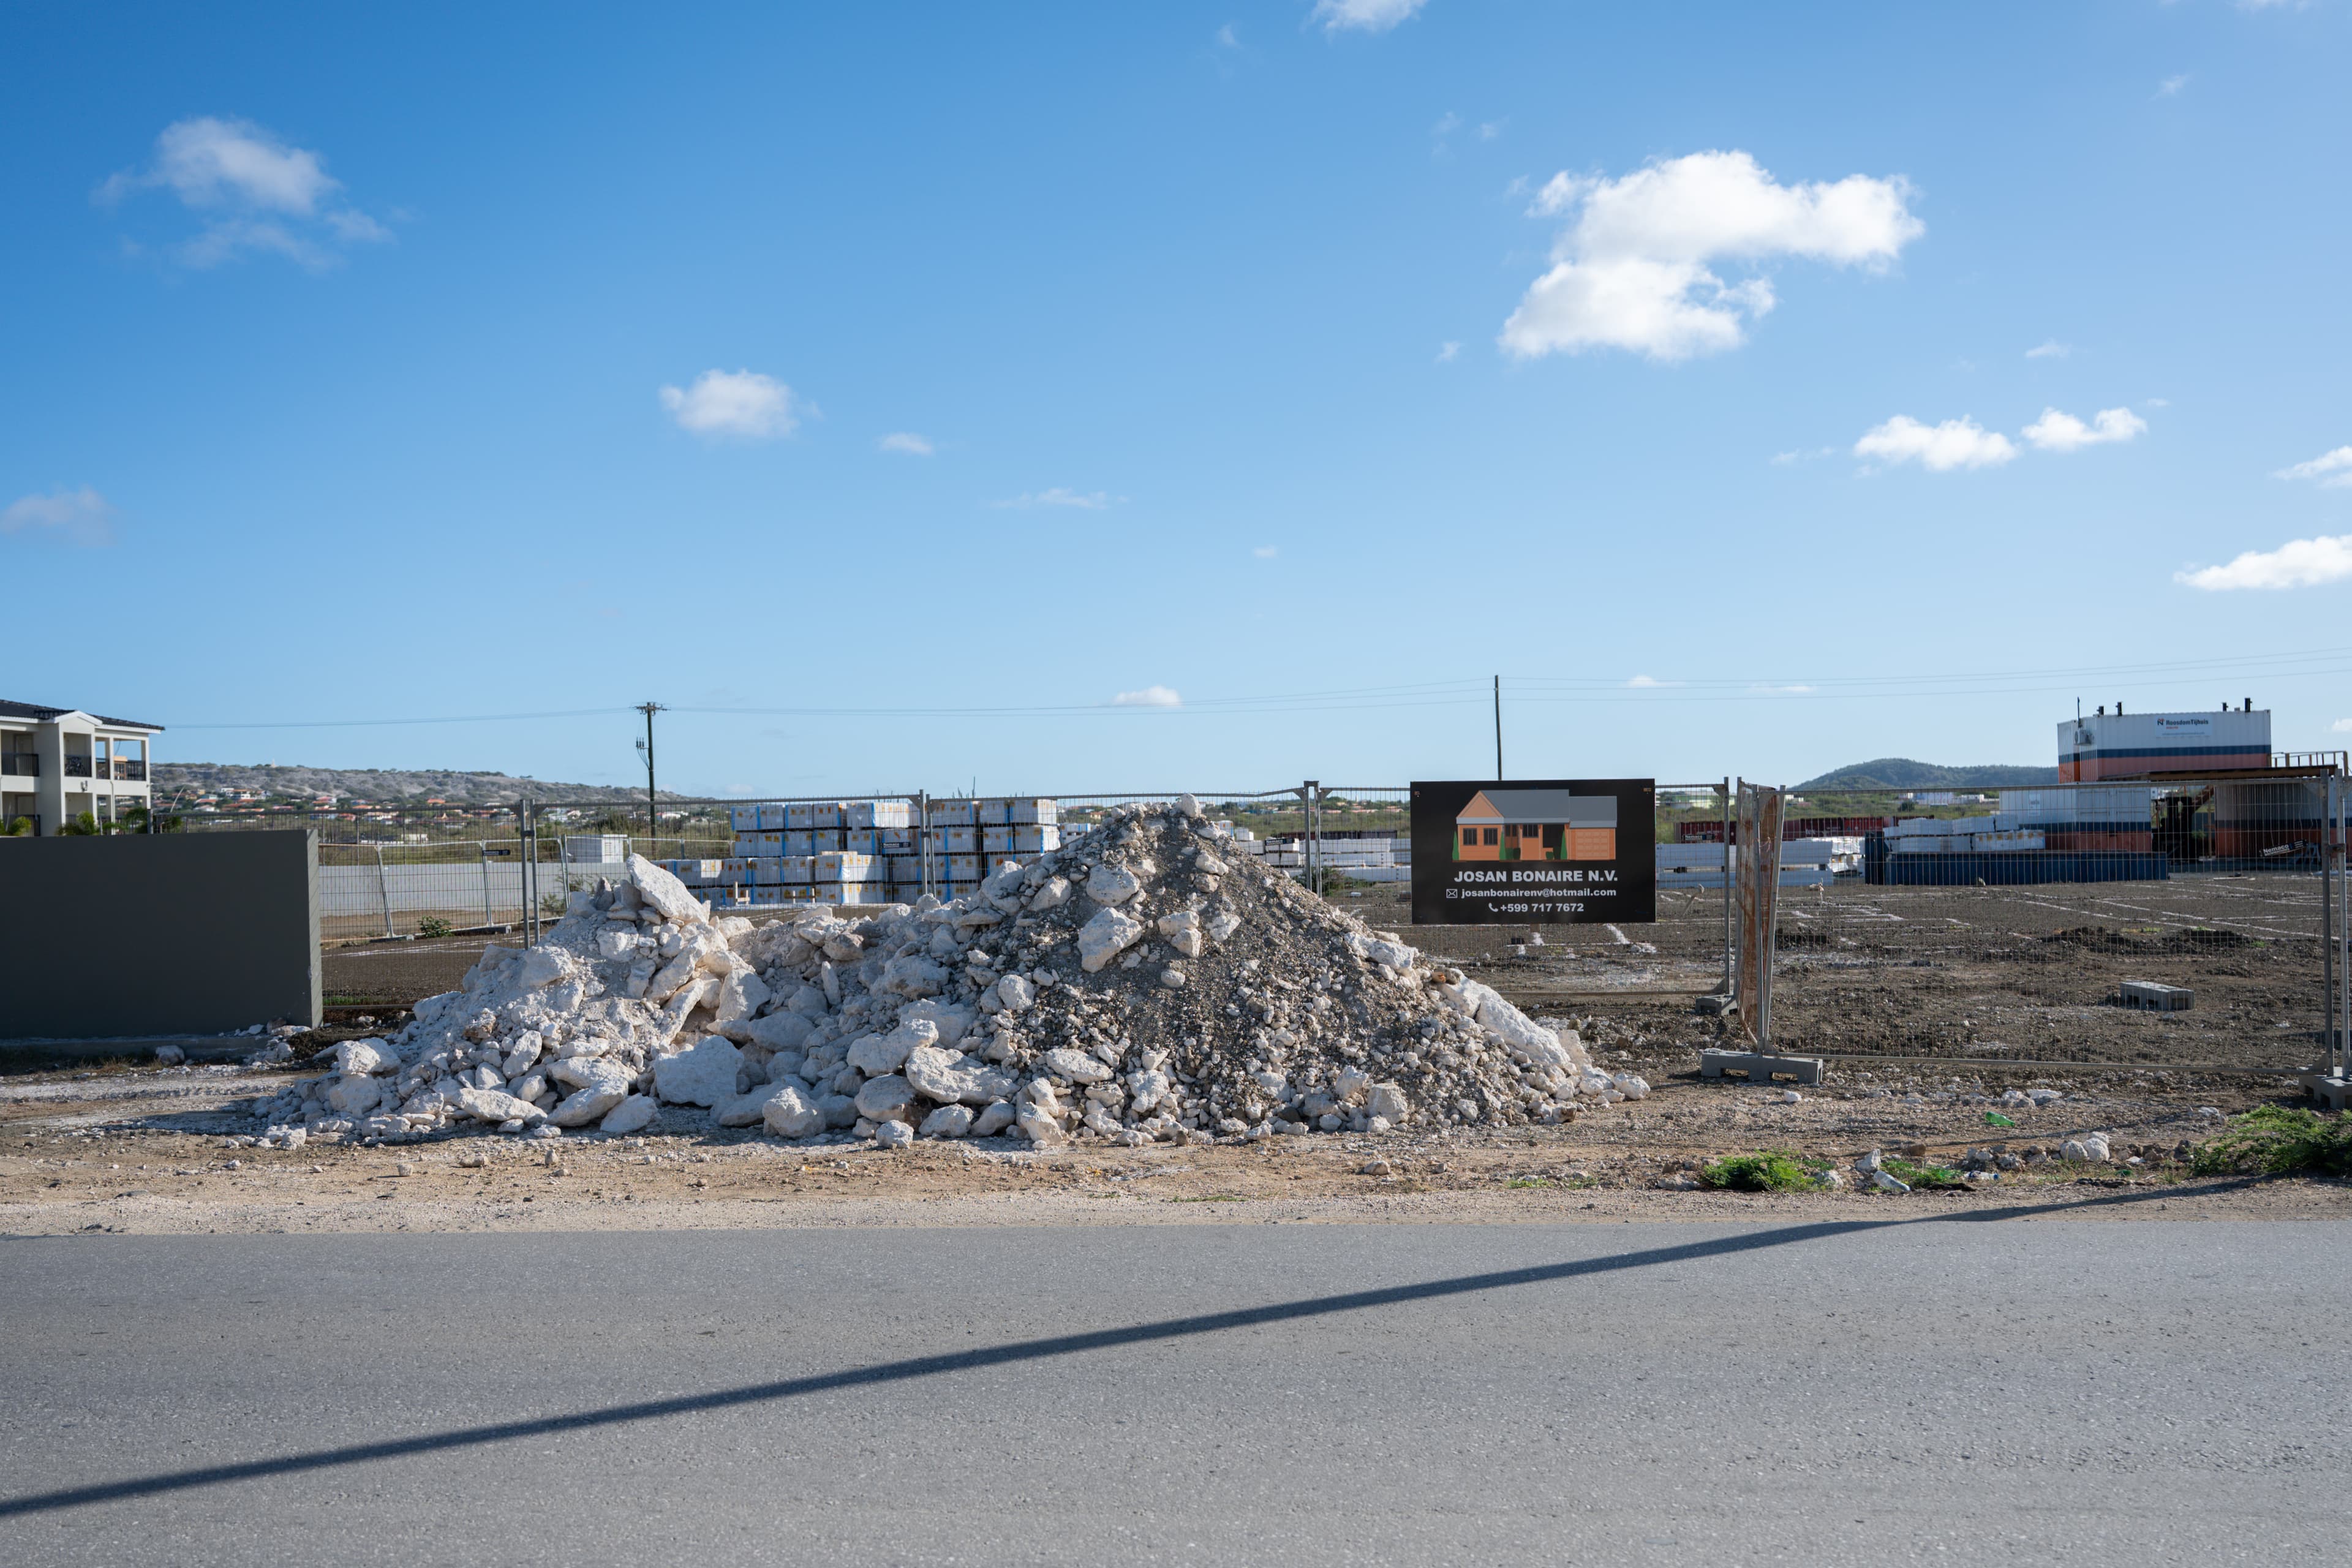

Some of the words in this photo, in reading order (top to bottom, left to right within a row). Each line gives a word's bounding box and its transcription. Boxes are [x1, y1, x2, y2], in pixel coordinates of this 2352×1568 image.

[2263, 844, 2289, 854] Nemaco
[1454, 871, 1507, 882] JOSAN
[1512, 870, 1583, 882] BONAIRE
[1588, 870, 1618, 881] N.V.
[1461, 888, 1616, 899] josanbonairenv@hotmail.com
[1500, 903, 1528, 912] +599
[1531, 903, 1553, 912] 717
[1556, 903, 1584, 912] 7672
